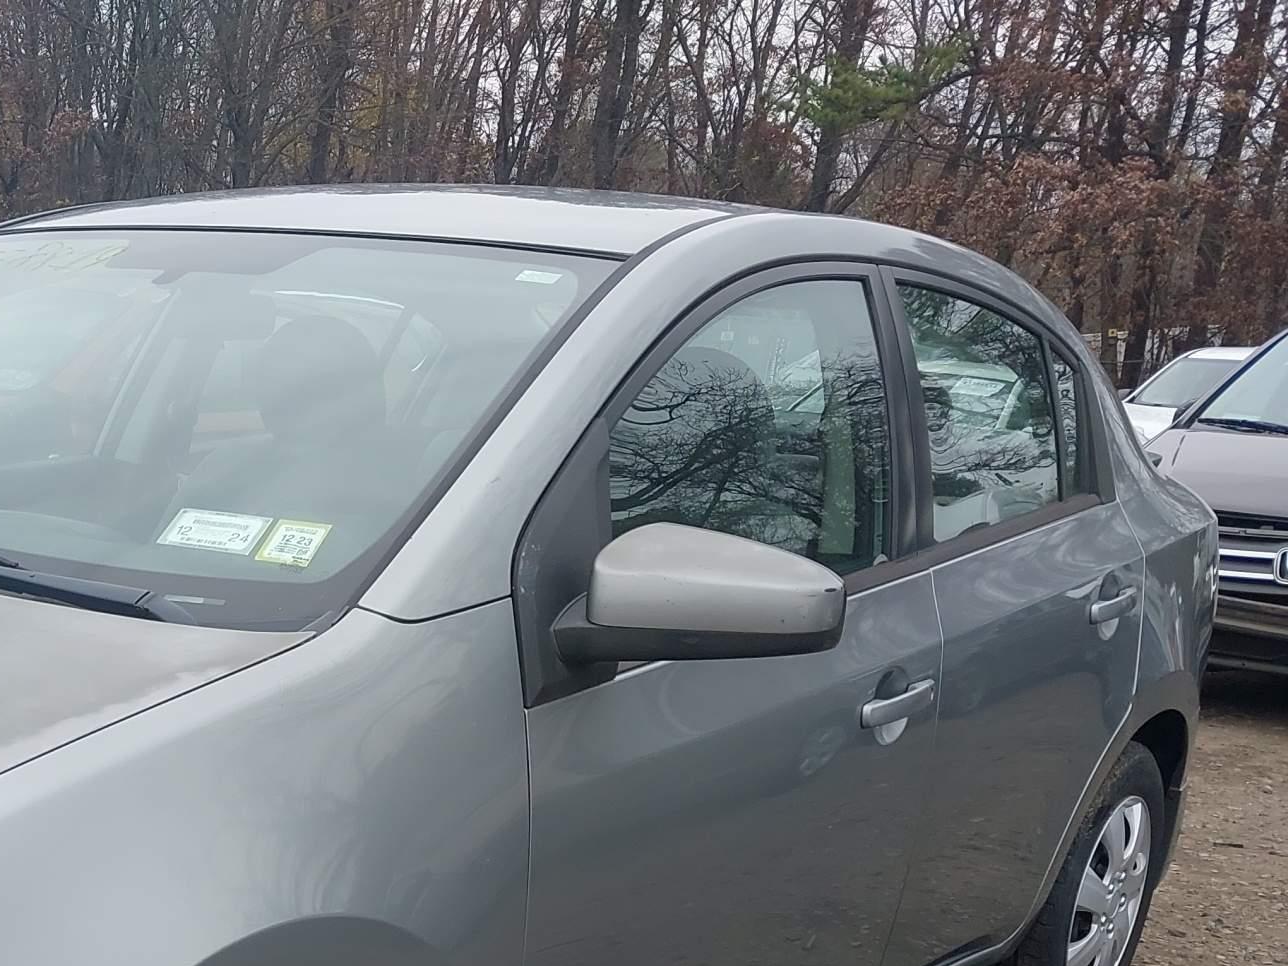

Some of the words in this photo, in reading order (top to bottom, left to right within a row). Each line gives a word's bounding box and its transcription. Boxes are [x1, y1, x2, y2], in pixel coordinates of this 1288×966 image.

[177, 524, 193, 536] 12
[227, 532, 250, 544] 24
[280, 533, 296, 543] 12
